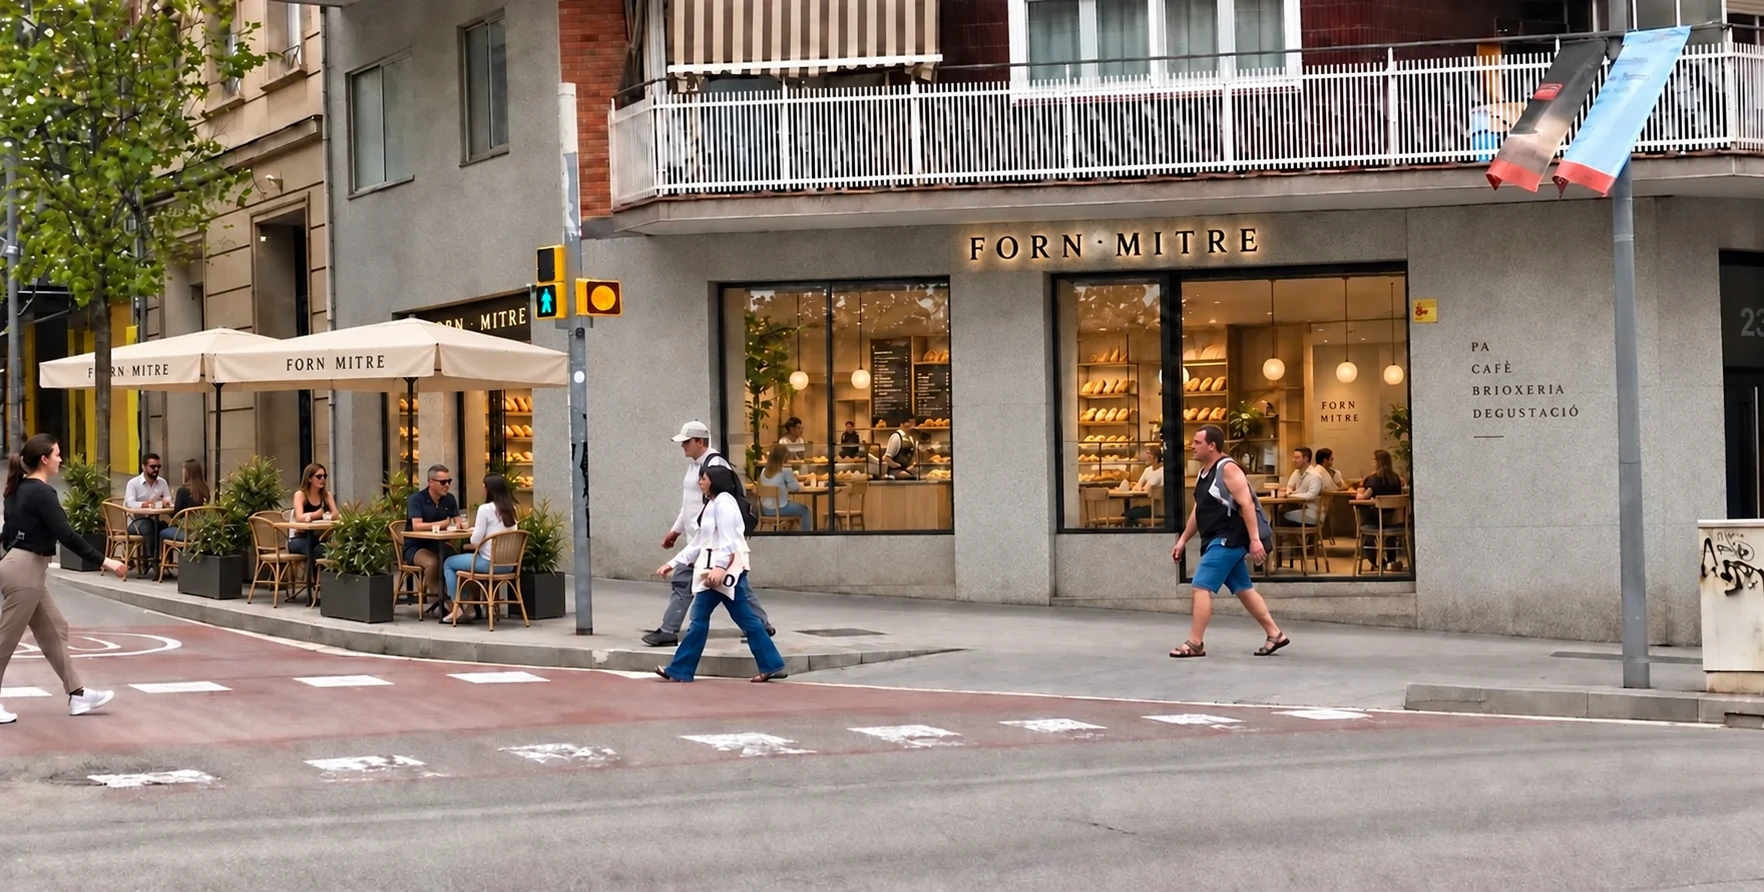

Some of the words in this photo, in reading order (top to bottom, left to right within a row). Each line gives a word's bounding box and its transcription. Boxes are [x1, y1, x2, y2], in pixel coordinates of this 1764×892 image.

[969, 234, 1083, 260] FORN
[1115, 228, 1259, 257] MITRE
[480, 307, 526, 331] MITRE
[1471, 342, 1490, 352] PA
[286, 357, 325, 371] FORN
[335, 355, 385, 369] MITRE
[1471, 360, 1512, 374] CAFÈ
[88, 366, 124, 378] FRN
[132, 364, 169, 376] MITRE
[1472, 384, 1564, 396] BRIOXERIA
[1321, 400, 1355, 410] FORN
[1473, 404, 1579, 419] DEGUSTACIÓ
[1320, 413, 1359, 423] MITRE
